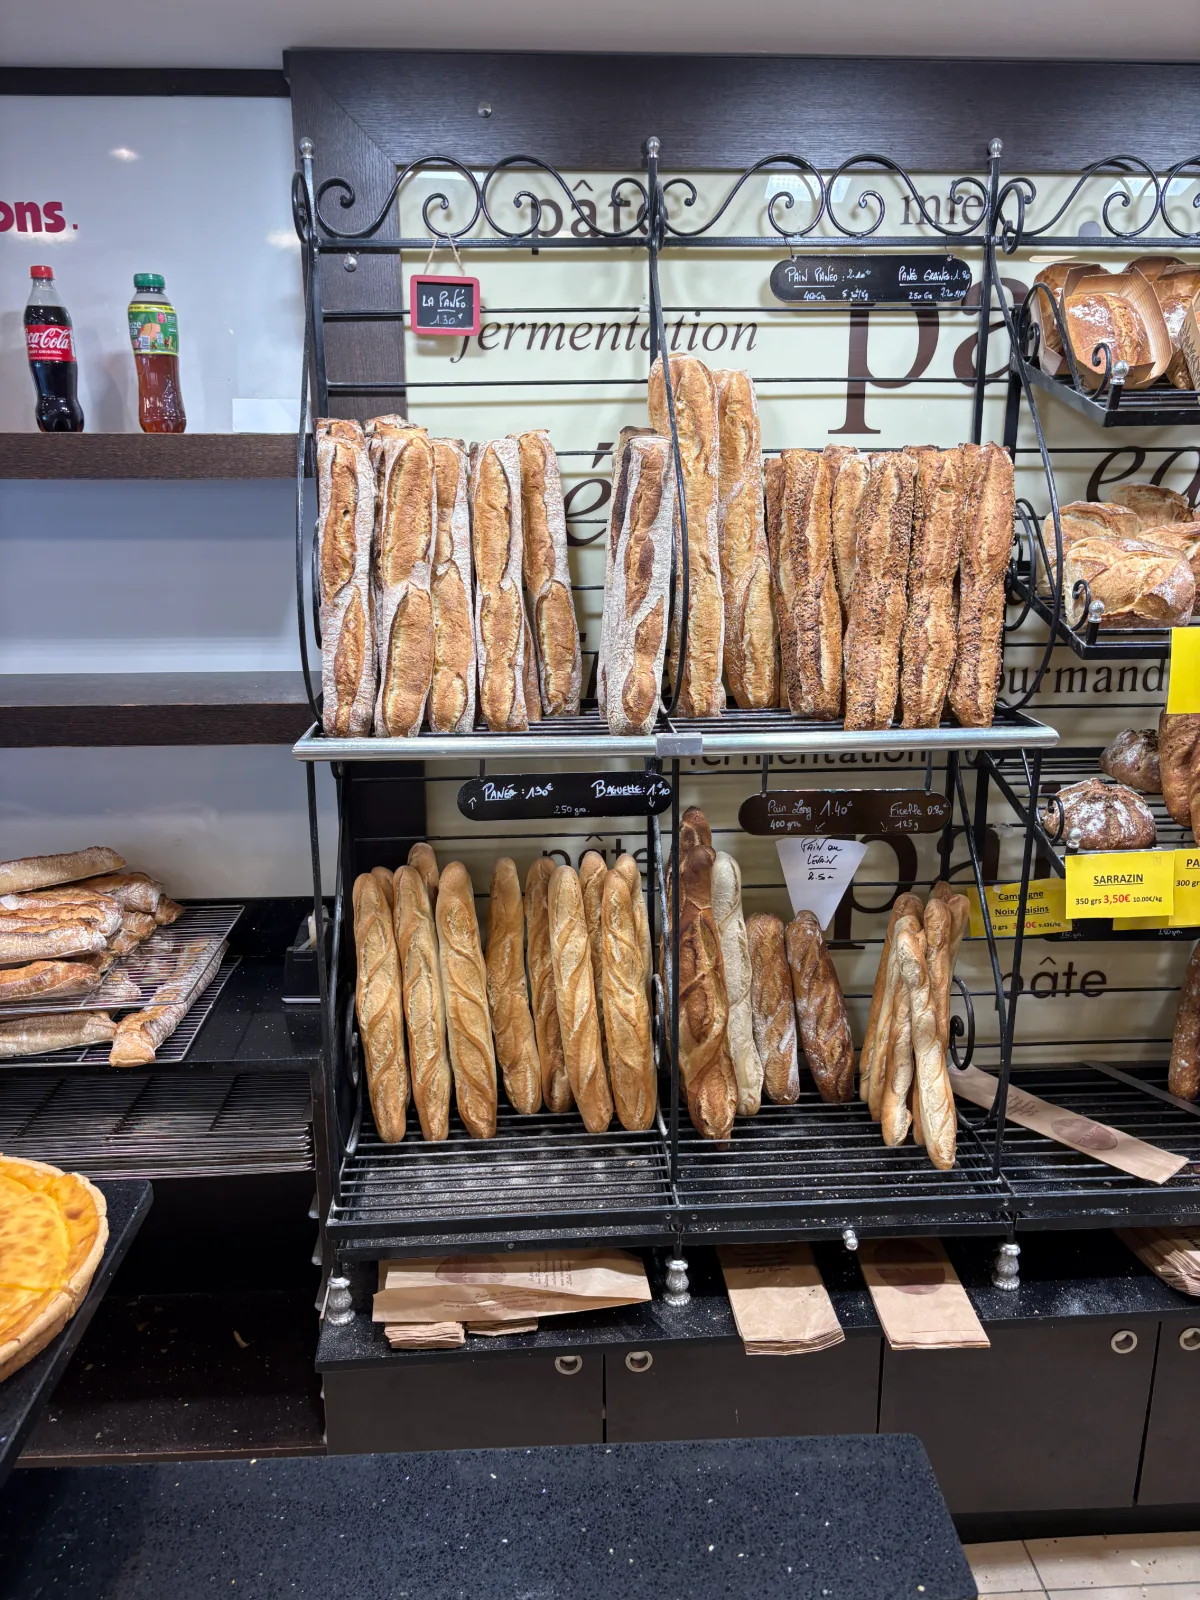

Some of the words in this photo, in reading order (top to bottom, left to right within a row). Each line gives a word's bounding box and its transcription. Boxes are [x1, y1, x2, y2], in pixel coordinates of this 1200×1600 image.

[900, 180, 984, 226] mie
[422, 294, 434, 307] LA
[999, 658, 1166, 695] urmand
[767, 799, 787, 813] Pain
[1093, 873, 1144, 886] SARRAZIN
[998, 890, 1044, 902] Camgne
[1076, 898, 1089, 906] 350
[1090, 898, 1102, 906] grs
[1103, 893, 1131, 905] 3,50€
[994, 905, 1050, 917] Noix/aisins
[1012, 921, 1037, 929] 30€
